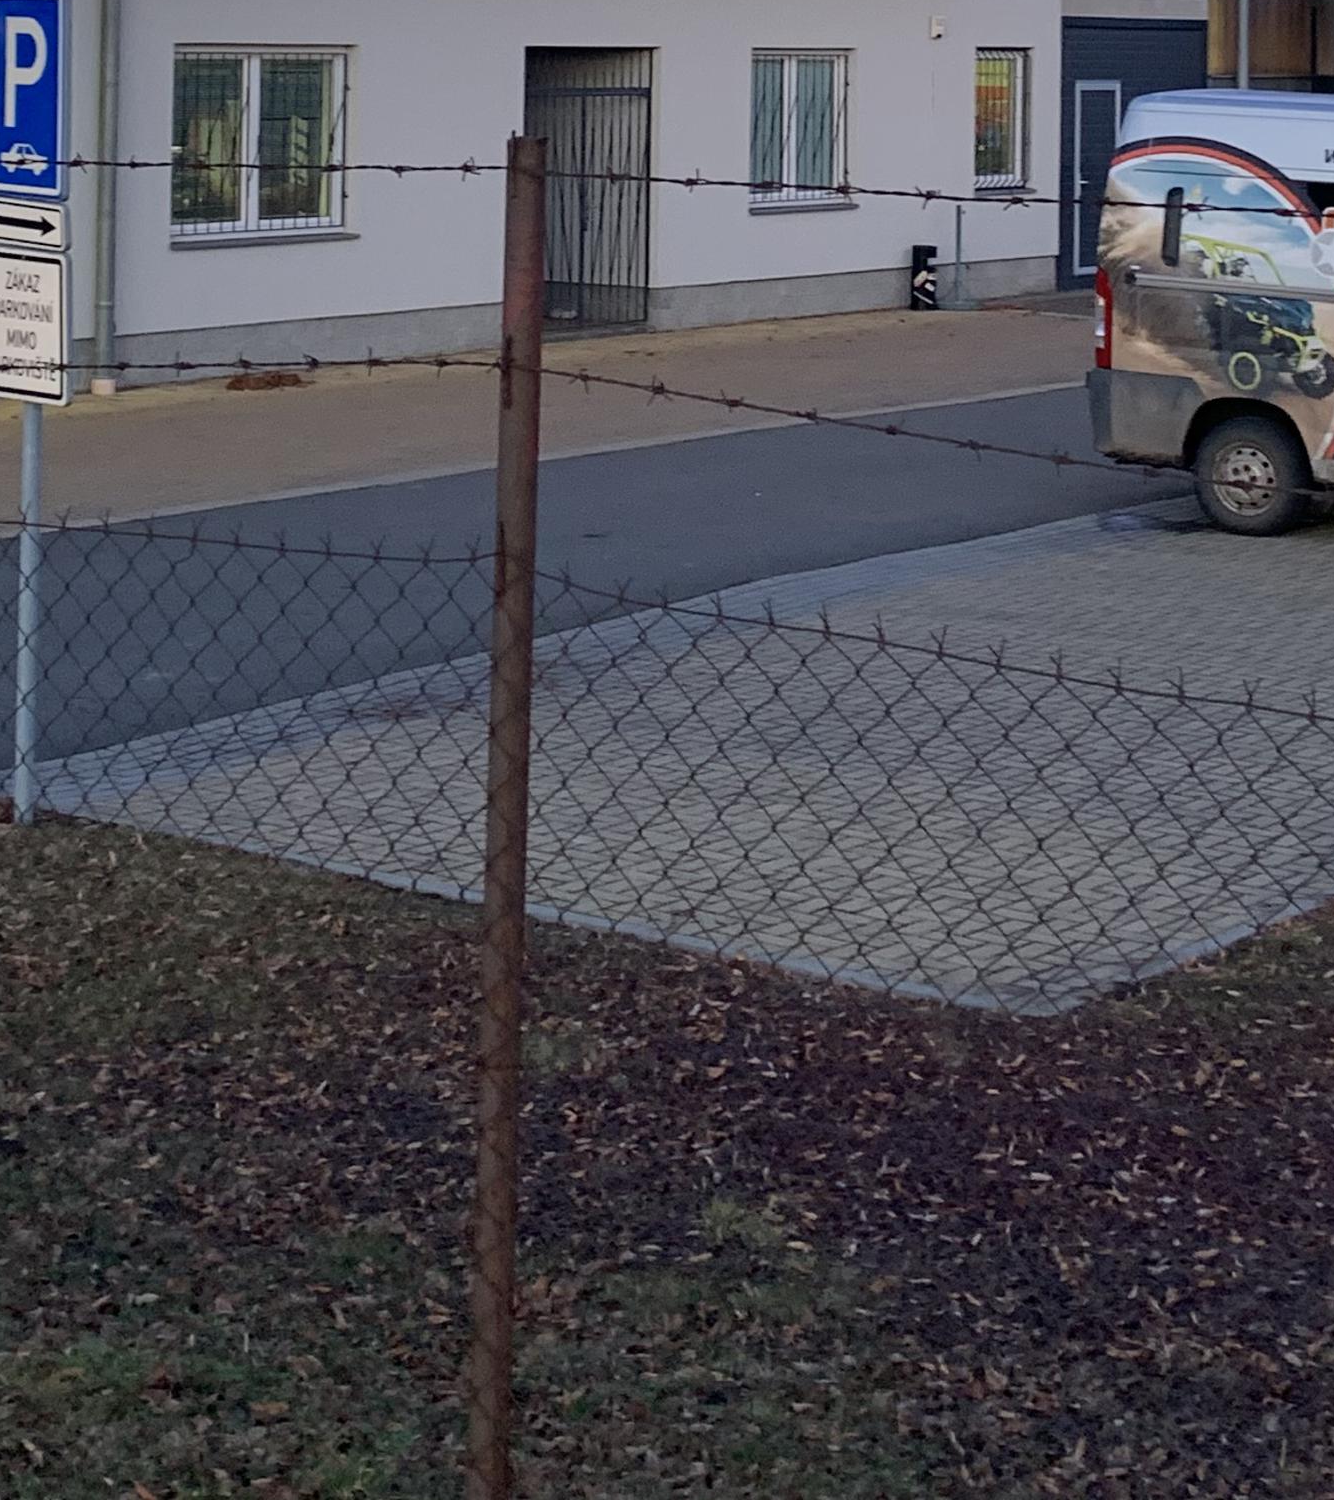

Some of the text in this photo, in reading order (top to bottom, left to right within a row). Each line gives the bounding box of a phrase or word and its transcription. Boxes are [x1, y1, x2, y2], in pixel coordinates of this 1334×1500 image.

[3, 15, 49, 128] P
[5, 267, 41, 294] ZÁKAZ
[6, 328, 38, 350] MIMO
